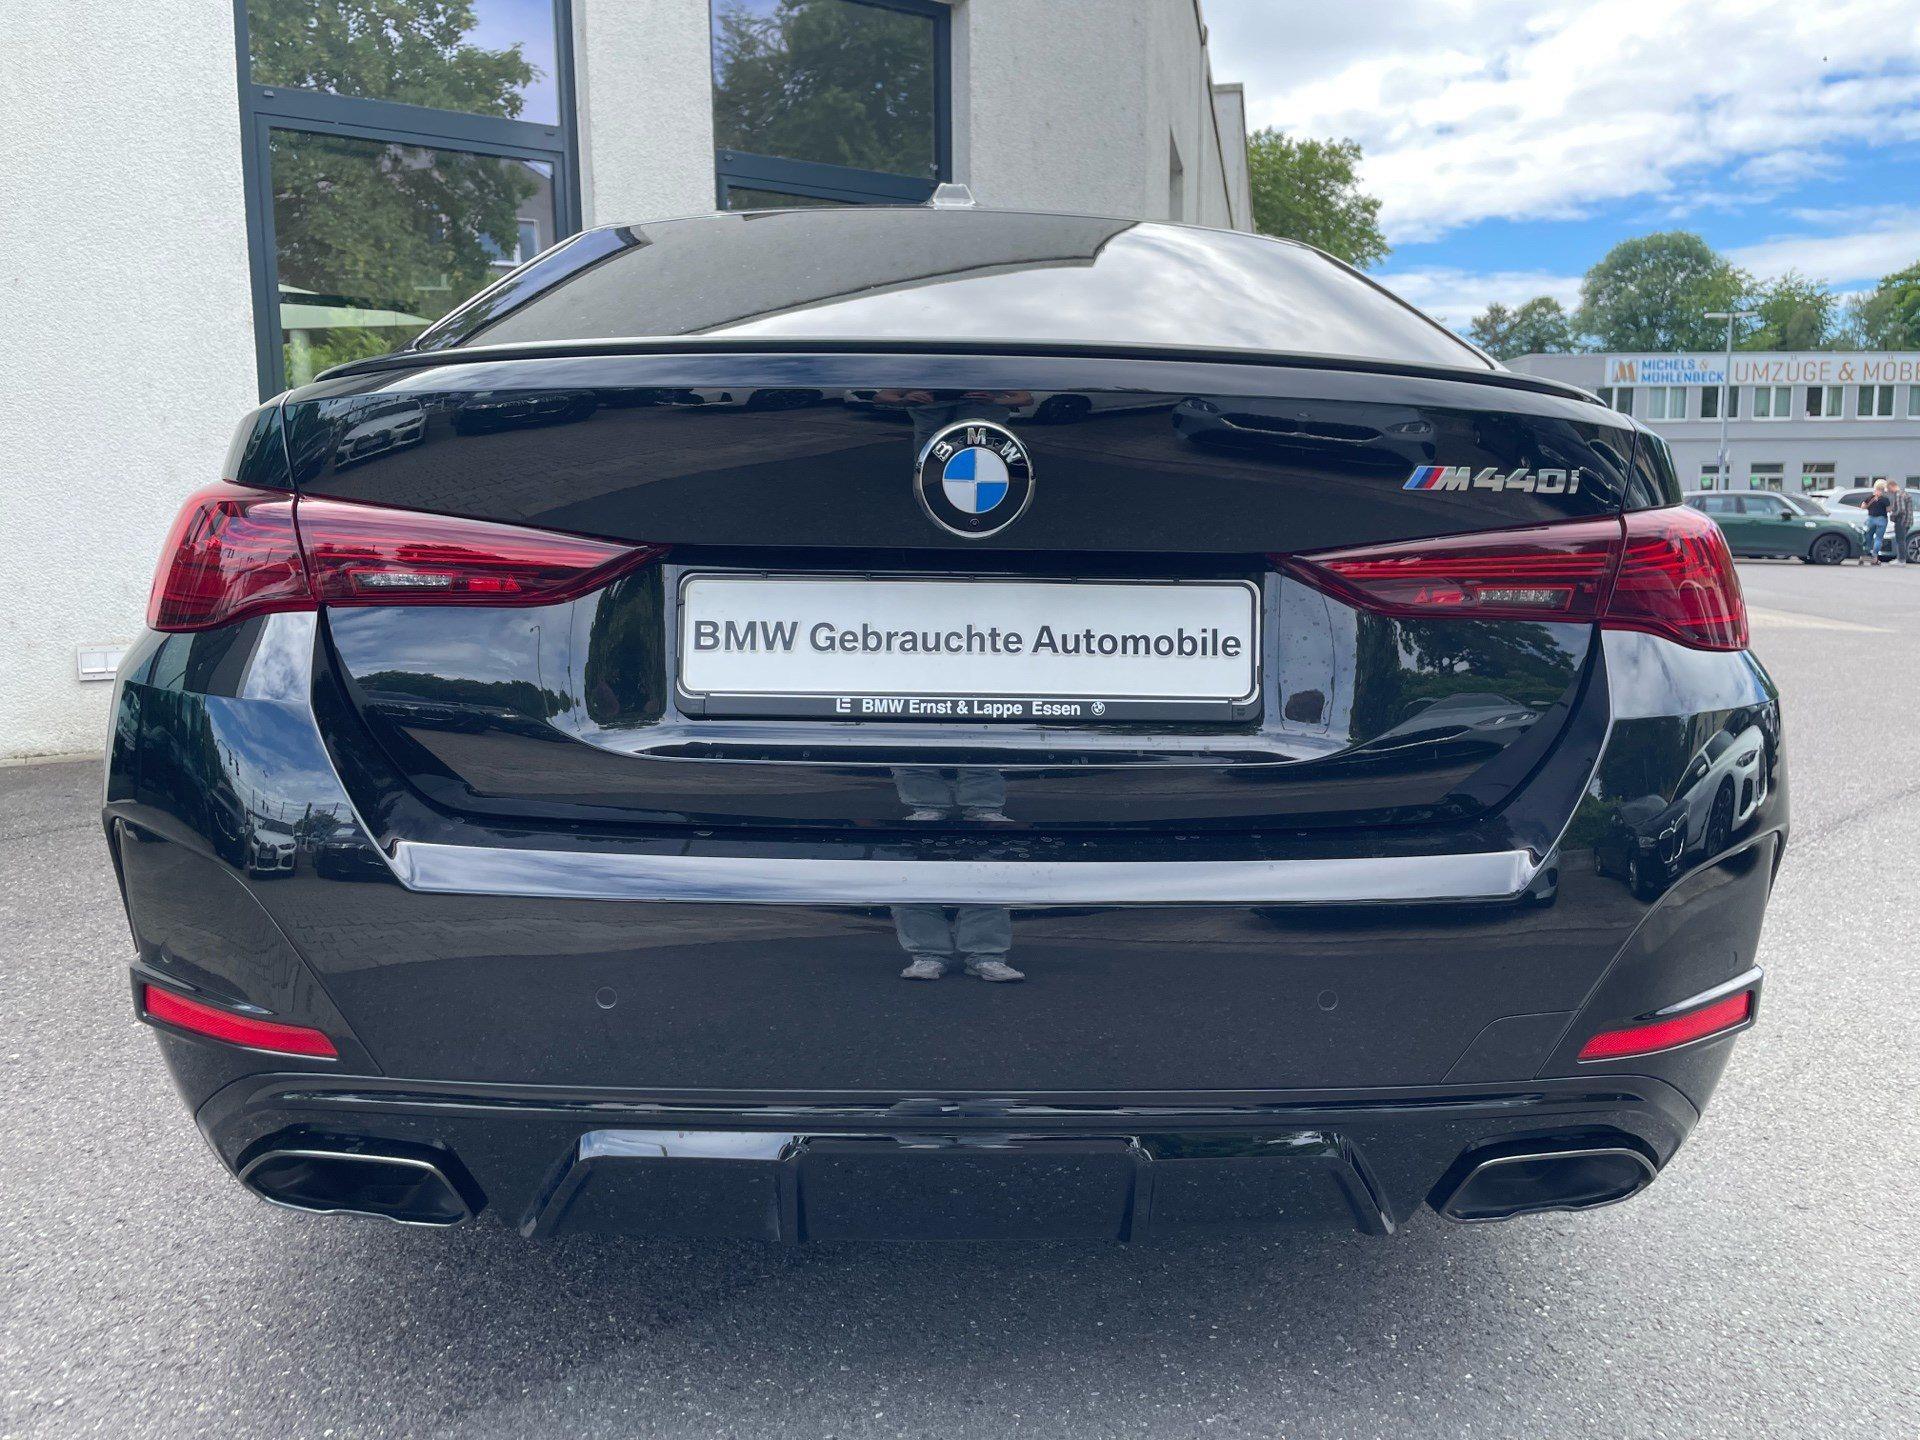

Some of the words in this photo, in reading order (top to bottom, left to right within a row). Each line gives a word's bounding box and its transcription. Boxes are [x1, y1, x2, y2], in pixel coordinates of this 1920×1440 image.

[1641, 358, 1696, 370] MICHELS
[1734, 354, 1832, 382] UMZÜGE
[1838, 361, 1857, 382] &
[932, 427, 1022, 463] BMW
[1431, 465, 1580, 495] M440i
[694, 620, 799, 651] BMW
[809, 622, 1023, 653] Gebrauchte
[1031, 625, 1242, 657] Automobile
[862, 698, 904, 713] BMW
[909, 699, 952, 714] Ernst
[956, 700, 969, 714] &
[973, 700, 1023, 718] Lappe
[1031, 701, 1081, 716] Essen
